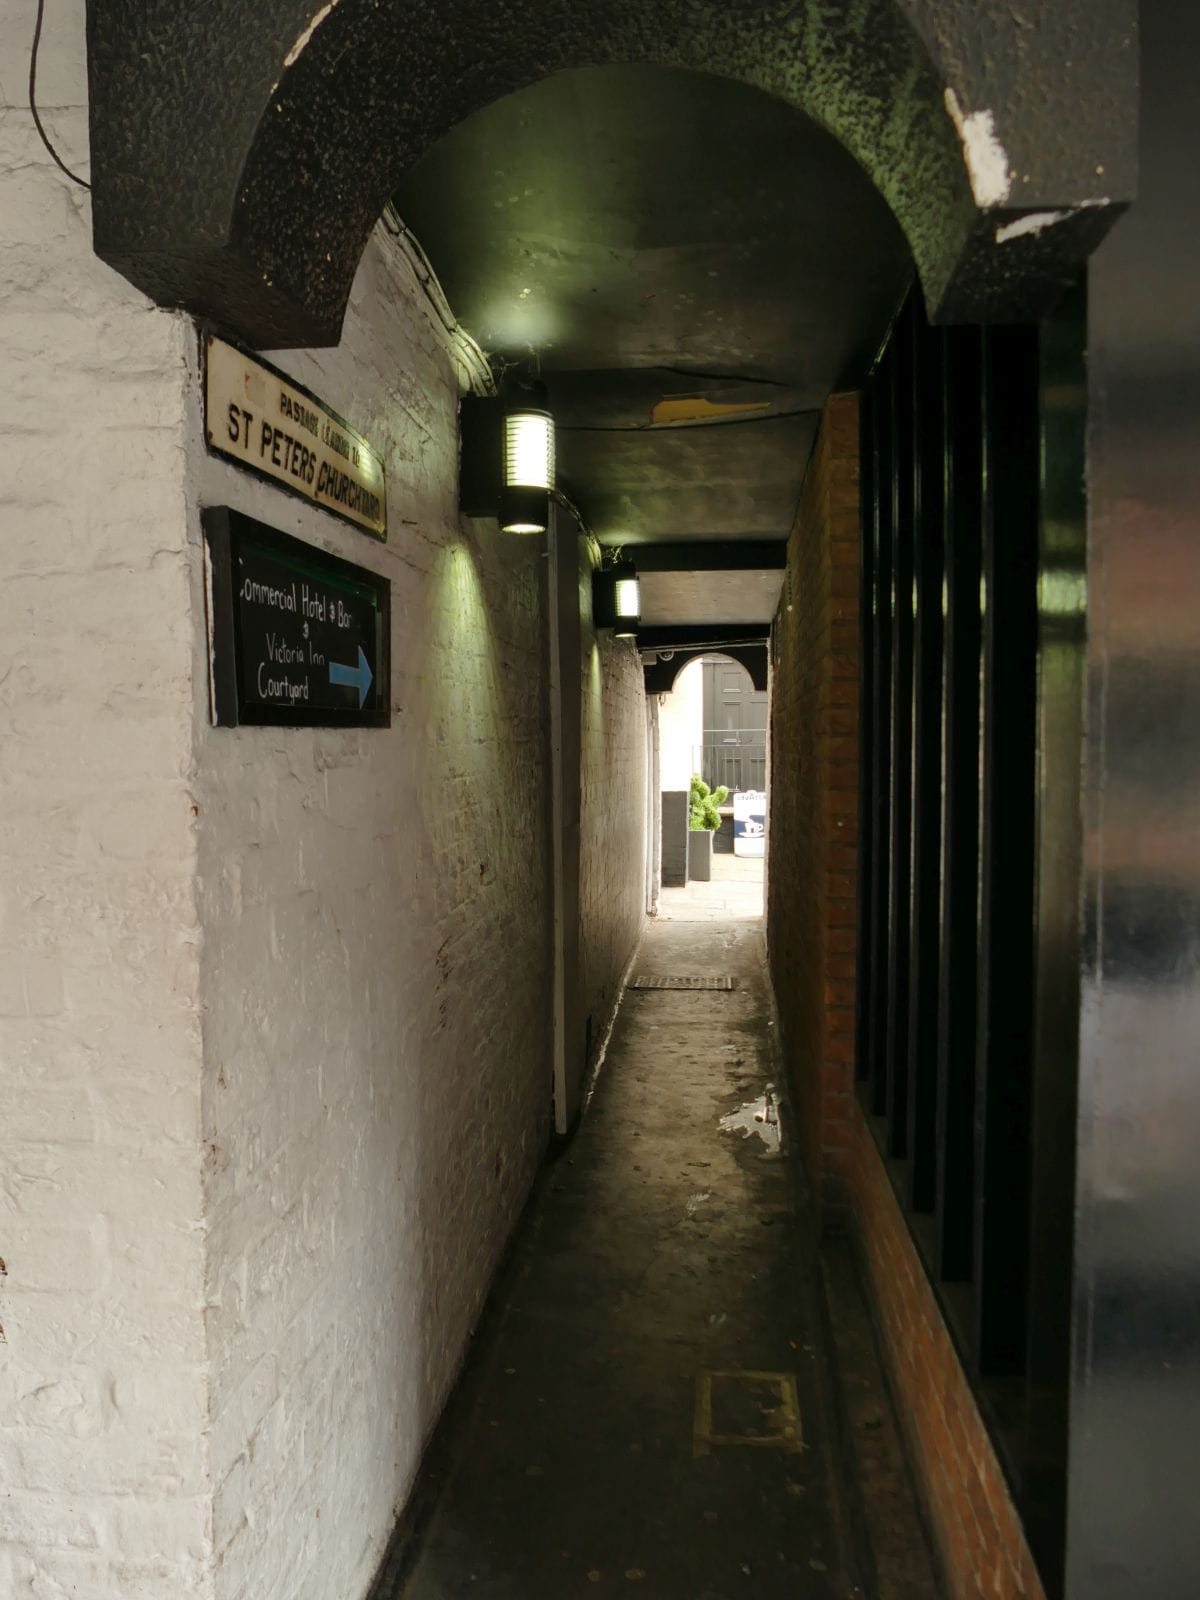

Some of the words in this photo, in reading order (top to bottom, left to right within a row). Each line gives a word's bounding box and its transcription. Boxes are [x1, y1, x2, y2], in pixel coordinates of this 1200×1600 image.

[228, 402, 253, 449] ST
[260, 419, 317, 485] PETERS
[317, 461, 380, 521] CHURCHYARD
[352, 446, 361, 468] TO
[240, 577, 297, 612] ommercial
[302, 584, 326, 622] Hotel
[337, 601, 353, 629] Bar
[266, 632, 305, 663] Victoria
[309, 641, 325, 666] Inn
[257, 662, 310, 704] Courtyard
